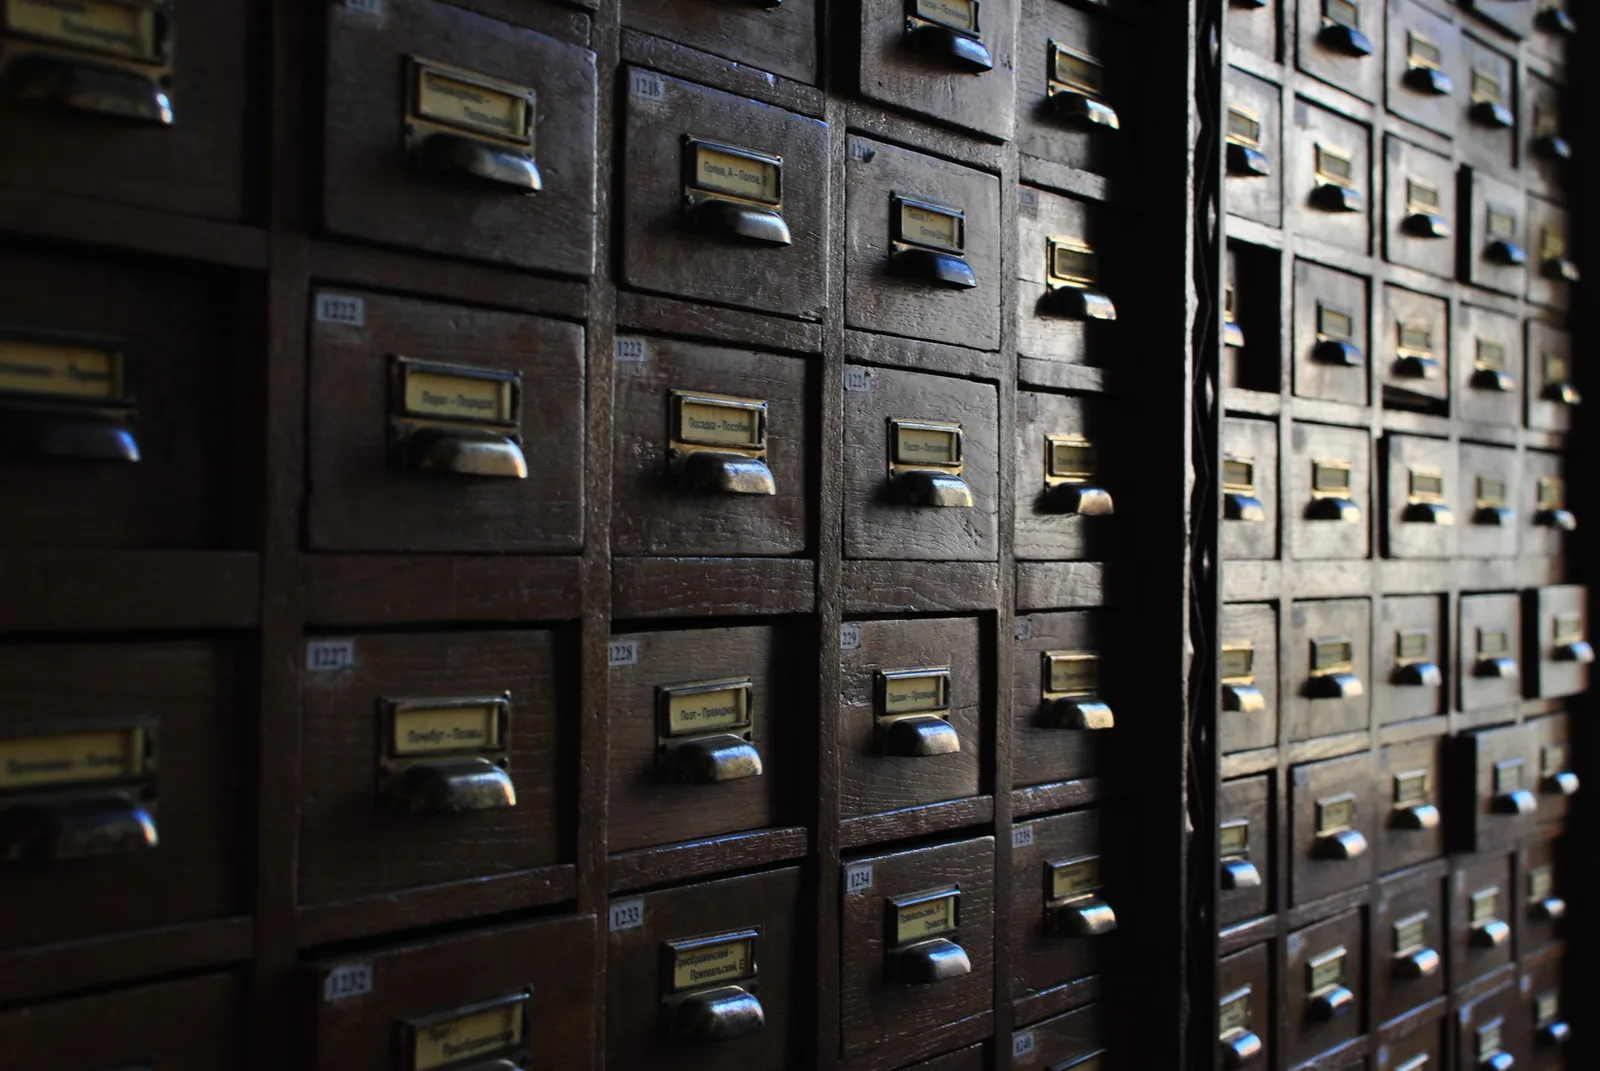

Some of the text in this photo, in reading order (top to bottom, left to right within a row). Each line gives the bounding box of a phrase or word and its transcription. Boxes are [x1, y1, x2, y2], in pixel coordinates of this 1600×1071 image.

[323, 300, 356, 320] 1222
[617, 341, 642, 358] 1223
[689, 417, 716, 431] Посадка
[314, 647, 347, 666] 1227
[609, 645, 632, 662] 1228
[851, 872, 870, 888] 1234
[614, 906, 639, 927] 1233
